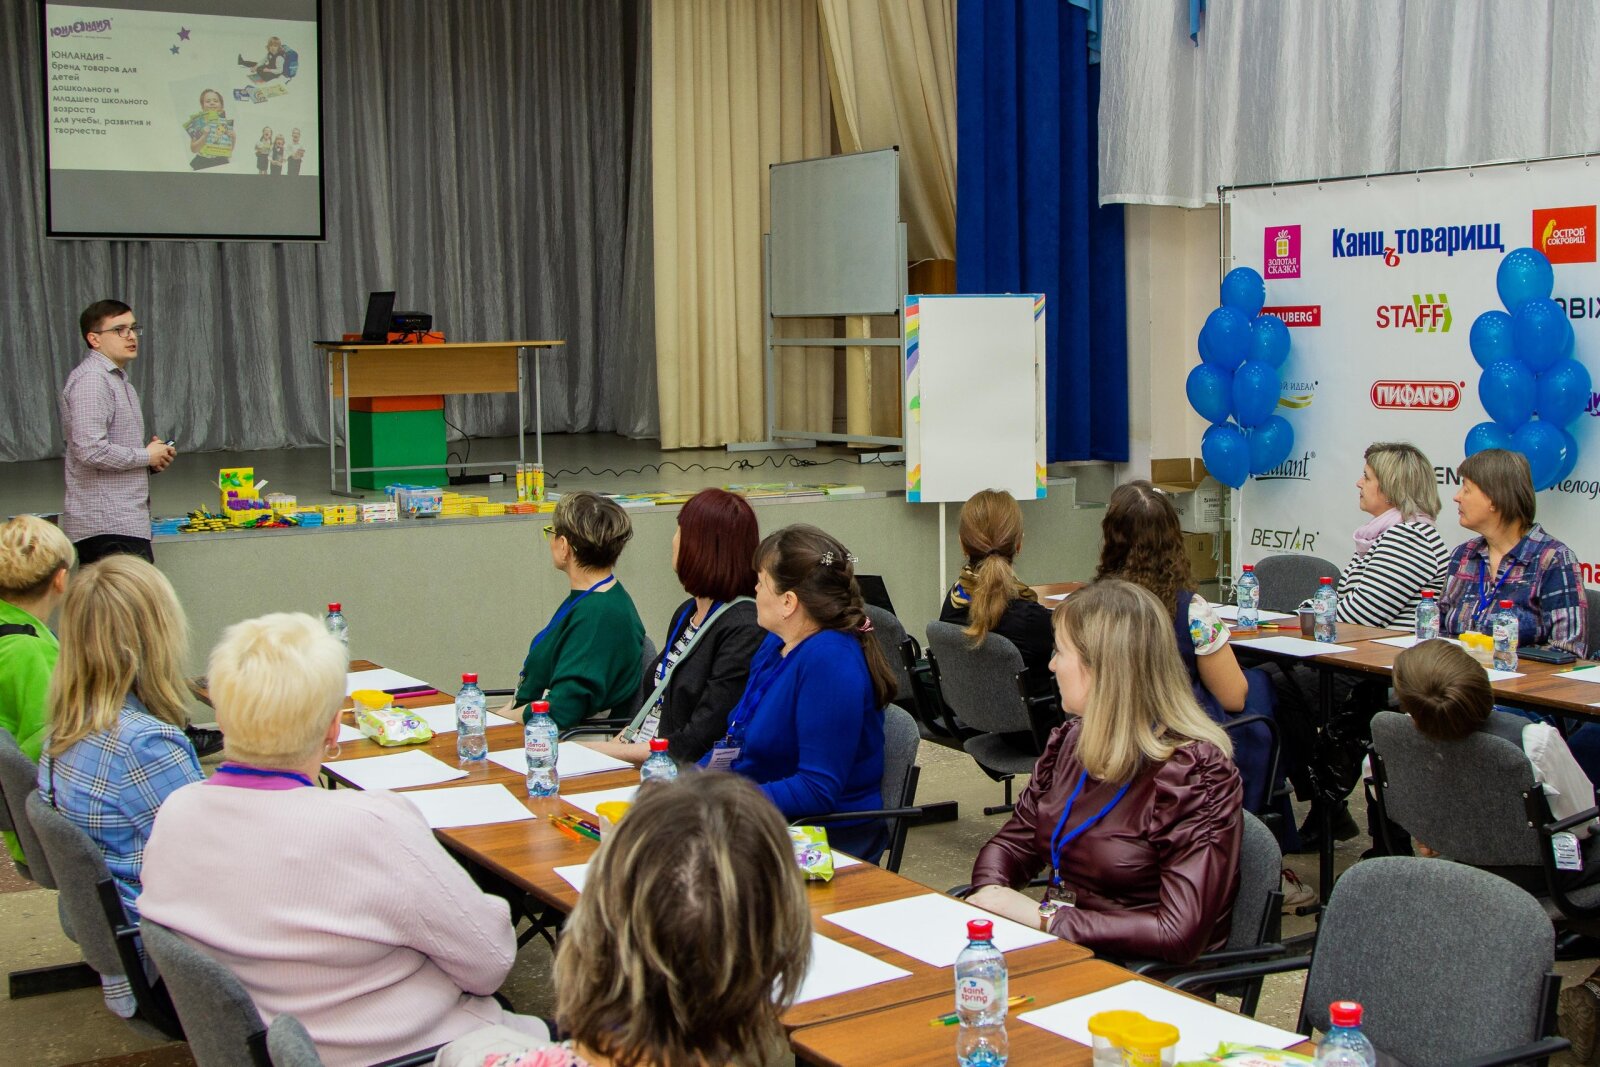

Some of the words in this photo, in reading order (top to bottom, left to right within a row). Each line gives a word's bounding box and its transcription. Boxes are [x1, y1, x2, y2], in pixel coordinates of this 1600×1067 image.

[51, 51, 104, 61] ЮНЛАНДИЯ
[51, 62, 80, 71] бренд
[83, 64, 120, 73] товаров
[51, 73, 80, 81] детей
[52, 85, 112, 93] дошкольного
[52, 95, 99, 104] младшего
[101, 97, 149, 105] школьного
[53, 106, 96, 114] возраста
[104, 118, 144, 126] развития
[54, 127, 107, 135] творчества
[1552, 227, 1585, 238] ОСТРОВ
[1547, 236, 1586, 246] СОКРОВИЩ
[1268, 258, 1297, 266] ЗОЛОТАЯ
[1268, 265, 1297, 274] СКАЗКА
[1376, 304, 1444, 328] STAFF
[1290, 382, 1315, 391] ИДЕАЛ
[1376, 384, 1456, 407] ПИФАГОР
[961, 993, 987, 1003] spring
